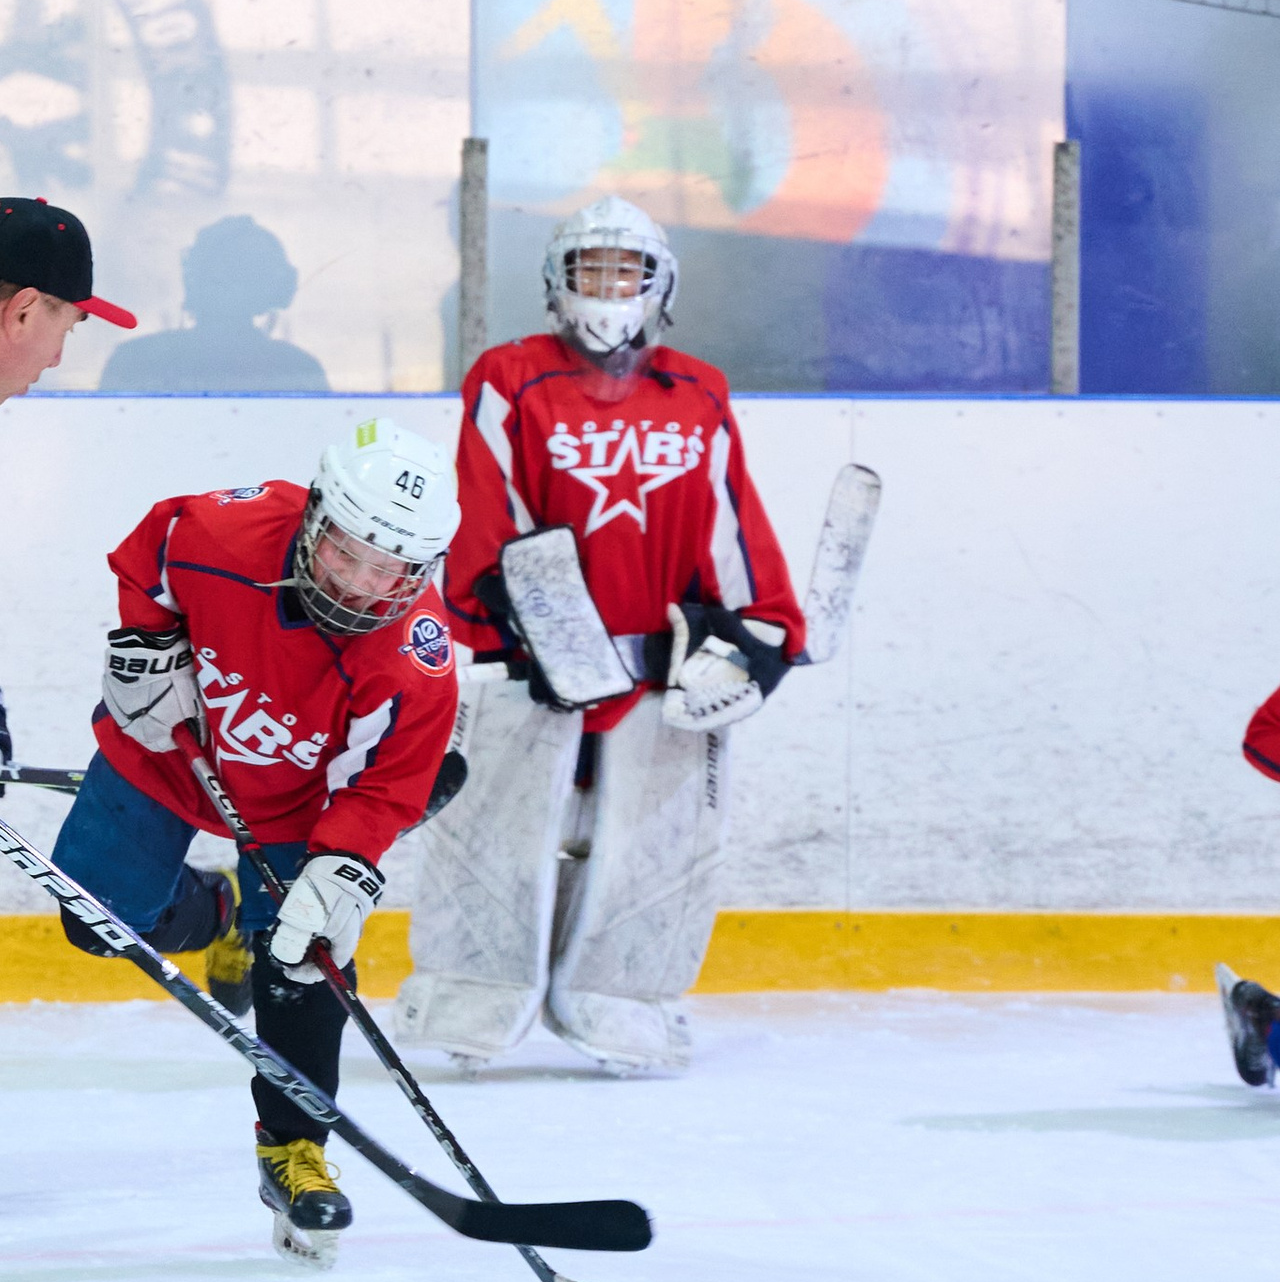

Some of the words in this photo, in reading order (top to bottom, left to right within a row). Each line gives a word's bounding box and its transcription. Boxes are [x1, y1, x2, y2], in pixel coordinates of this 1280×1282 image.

[546, 424, 706, 471] STARS
[395, 470, 426, 501] 46
[413, 620, 439, 644] 10
[109, 649, 195, 675] BAUE
[191, 642, 329, 746] OSTON
[196, 652, 329, 771] TARS
[207, 774, 252, 833] CCM
